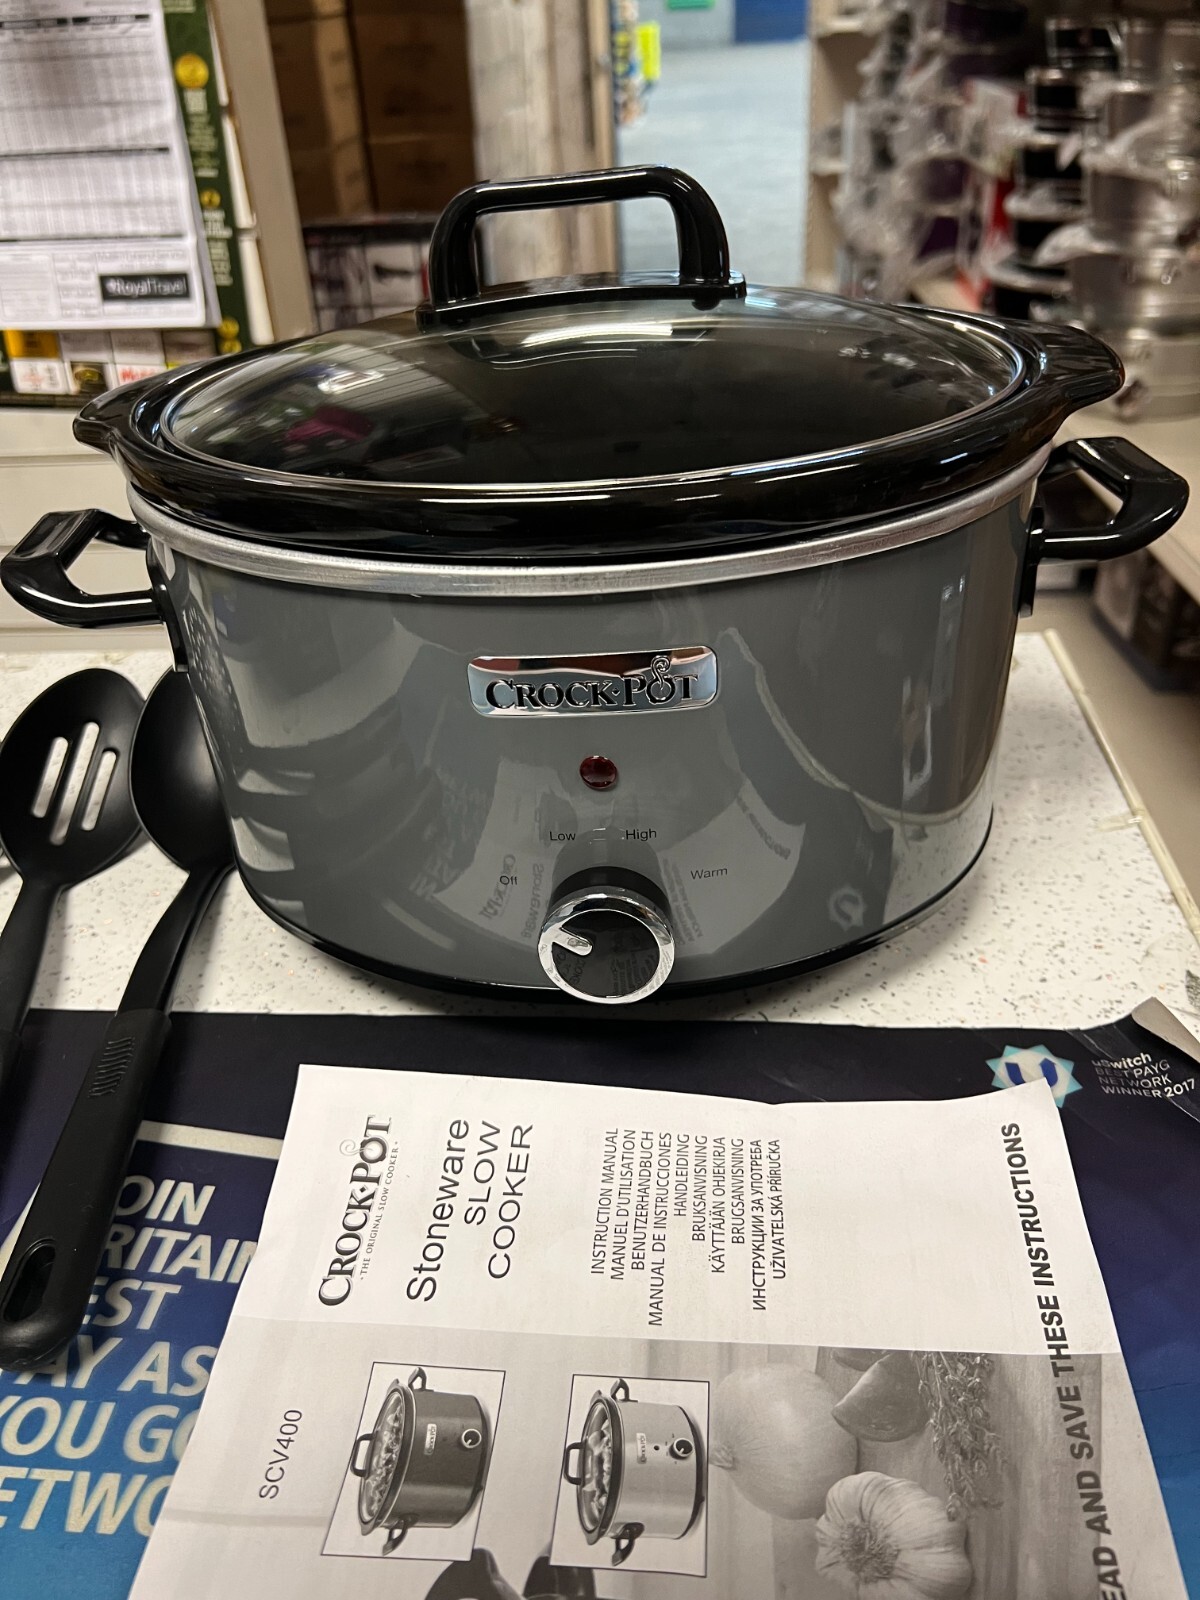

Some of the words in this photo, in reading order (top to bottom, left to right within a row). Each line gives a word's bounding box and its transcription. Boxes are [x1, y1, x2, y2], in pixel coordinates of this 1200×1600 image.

[550, 831, 576, 842] Low
[625, 828, 657, 842] High
[499, 874, 518, 886] Off
[691, 866, 728, 881] Warm
[1098, 1073, 1172, 1089] NETWORK
[1101, 1085, 1162, 1098] WINNER
[1164, 1078, 1195, 1098] 2017
[1133, 1059, 1170, 1078] PAYG
[463, 1120, 501, 1226] SLOW
[601, 1128, 618, 1184] MANUAL
[653, 1132, 672, 1229] INSTRUCCIONES
[674, 1134, 690, 1217] HANDLEIDING
[692, 1135, 707, 1242] BRUKSANVISNING
[712, 1136, 726, 1197] OHJEKIRJA
[750, 1139, 763, 1197] УПОТРЕБА
[766, 1139, 782, 1192] PŘÍRUČKA
[116, 1175, 216, 1226] OIN
[360, 1257, 371, 1276] THE
[367, 1212, 383, 1254] ORIGINAL
[378, 1187, 389, 1211] SLOW
[385, 1147, 399, 1185] COOKER
[406, 1119, 470, 1302] Stoneware
[487, 1124, 534, 1279] COOKER
[631, 1130, 653, 1271] BENUTZERHANDBUCH
[731, 1138, 745, 1244] BRUGSANVISNING
[751, 1202, 764, 1213] ЗА
[1001, 1122, 1055, 1287] INSTRUCTIONS
[104, 1223, 258, 1284] RITAI
[591, 1188, 613, 1275] INSTRUCTION
[610, 1220, 628, 1281] MANUEL
[652, 1233, 666, 1252] DE
[708, 1201, 726, 1273] KÄYTTÄJÄN
[751, 1216, 767, 1311] ИНСТРУКЦИИ
[769, 1194, 786, 1279] UŽIVATELSKÁ
[648, 1257, 665, 1326] MANUAL
[13, 1334, 123, 1389] AY
[116, 1341, 219, 1397] AS
[1037, 1294, 1075, 1378] THESE
[259, 1408, 303, 1500] SCV400
[1056, 1385, 1094, 1461] SAVE
[1076, 1470, 1112, 1536] AND
[1092, 1546, 1127, 1600] EAD
